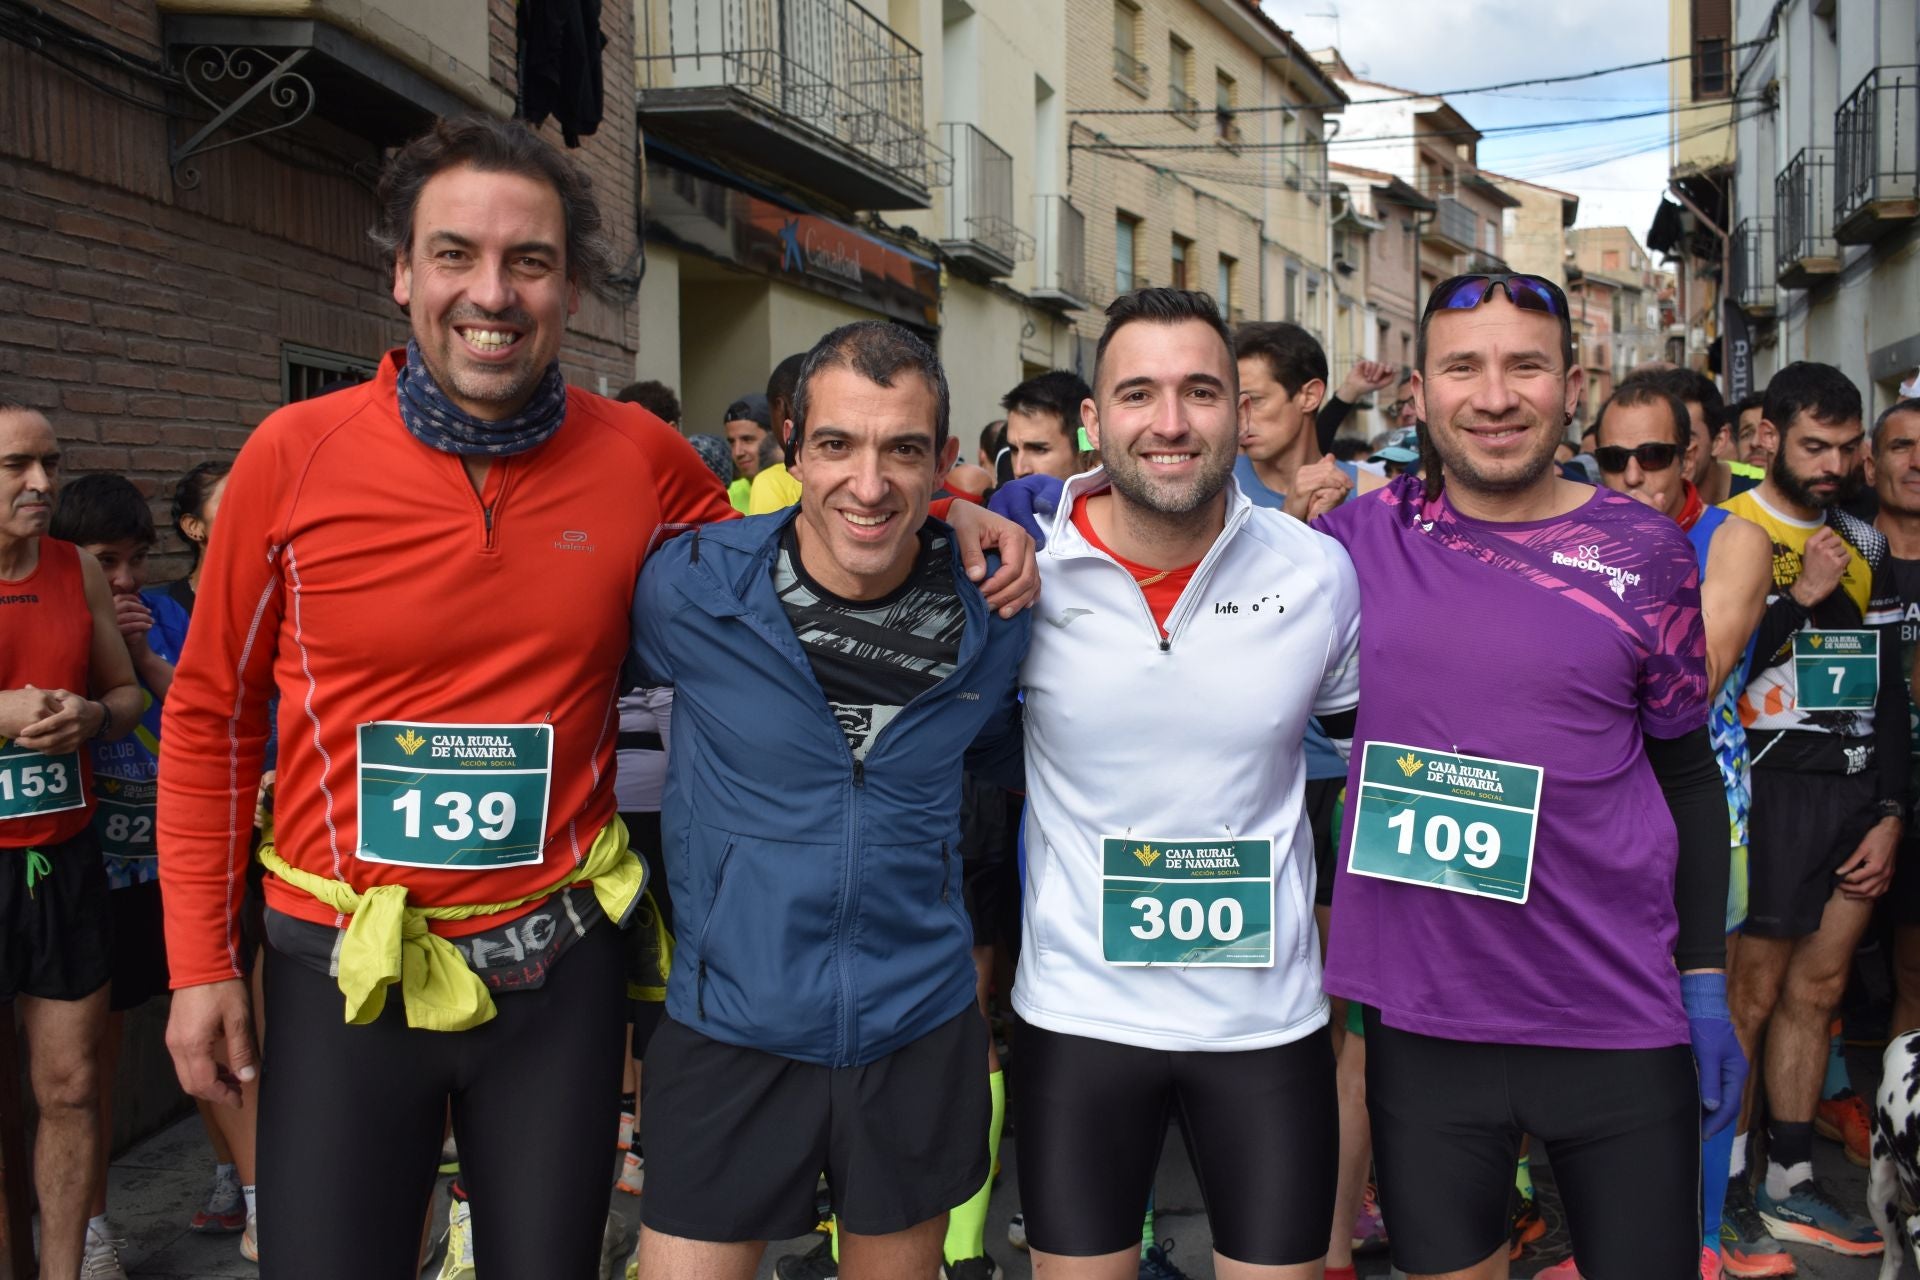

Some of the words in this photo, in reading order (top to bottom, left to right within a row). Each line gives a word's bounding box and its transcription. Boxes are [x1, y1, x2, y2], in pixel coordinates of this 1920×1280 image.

[1828, 667, 1846, 694] 7
[99, 743, 136, 760] CLUB
[431, 746, 451, 758] DE
[454, 747, 517, 758] NAVARRA
[432, 735, 465, 747] CAJA
[467, 735, 511, 747] RURAL
[0, 762, 68, 801] 153
[1426, 770, 1444, 784] DE
[1446, 774, 1504, 794] NAVARRA
[1428, 760, 1458, 778] CAJA
[1459, 765, 1500, 782] RURAL
[1451, 787, 1476, 797] ACCIÓN
[1478, 792, 1503, 802] SOCIAL
[392, 789, 517, 841] 139
[1388, 808, 1501, 869] 109
[1165, 849, 1194, 860] CAJA
[1196, 848, 1235, 858] RURAL
[1165, 859, 1182, 869] DE
[1185, 858, 1240, 869] NAVARRA
[1129, 896, 1243, 941] 300
